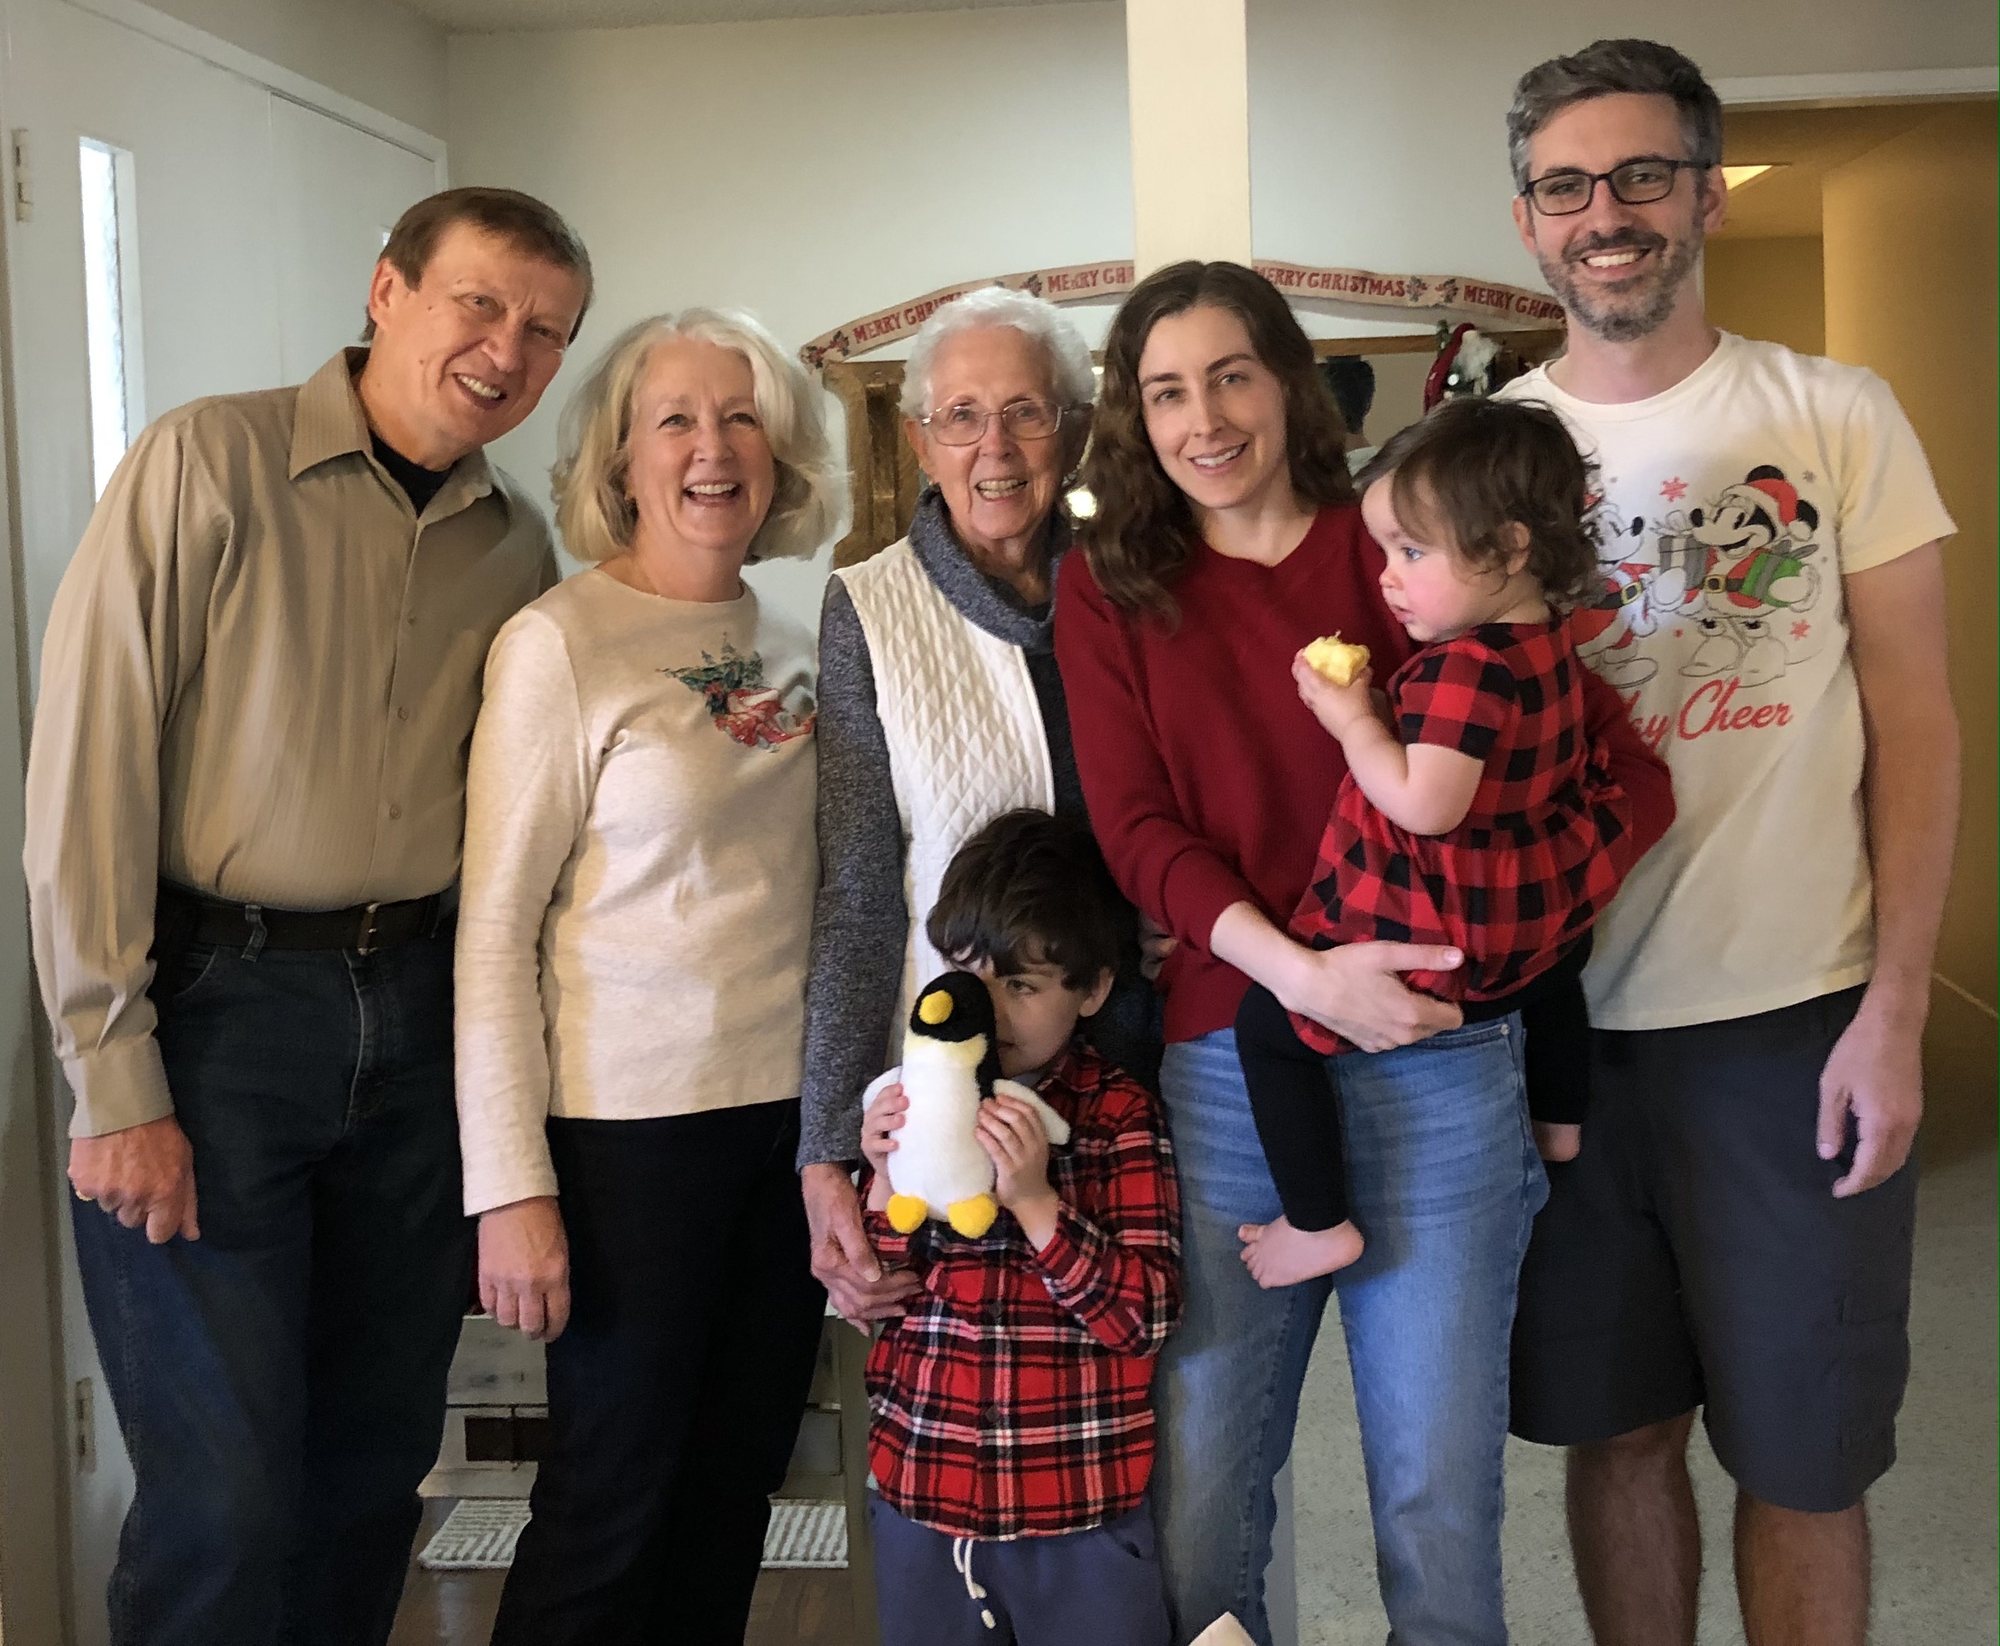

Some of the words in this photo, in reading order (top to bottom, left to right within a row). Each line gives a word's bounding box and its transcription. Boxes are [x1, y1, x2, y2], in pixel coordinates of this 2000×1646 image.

[852, 312, 901, 344] MERRY
[1047, 269, 1099, 293] MERRY
[1307, 272, 1405, 297] CHRISTMAS
[1464, 285, 1514, 310] MERRY
[1515, 296, 1567, 323] CHRIS
[1678, 676, 1793, 740] Cheer
